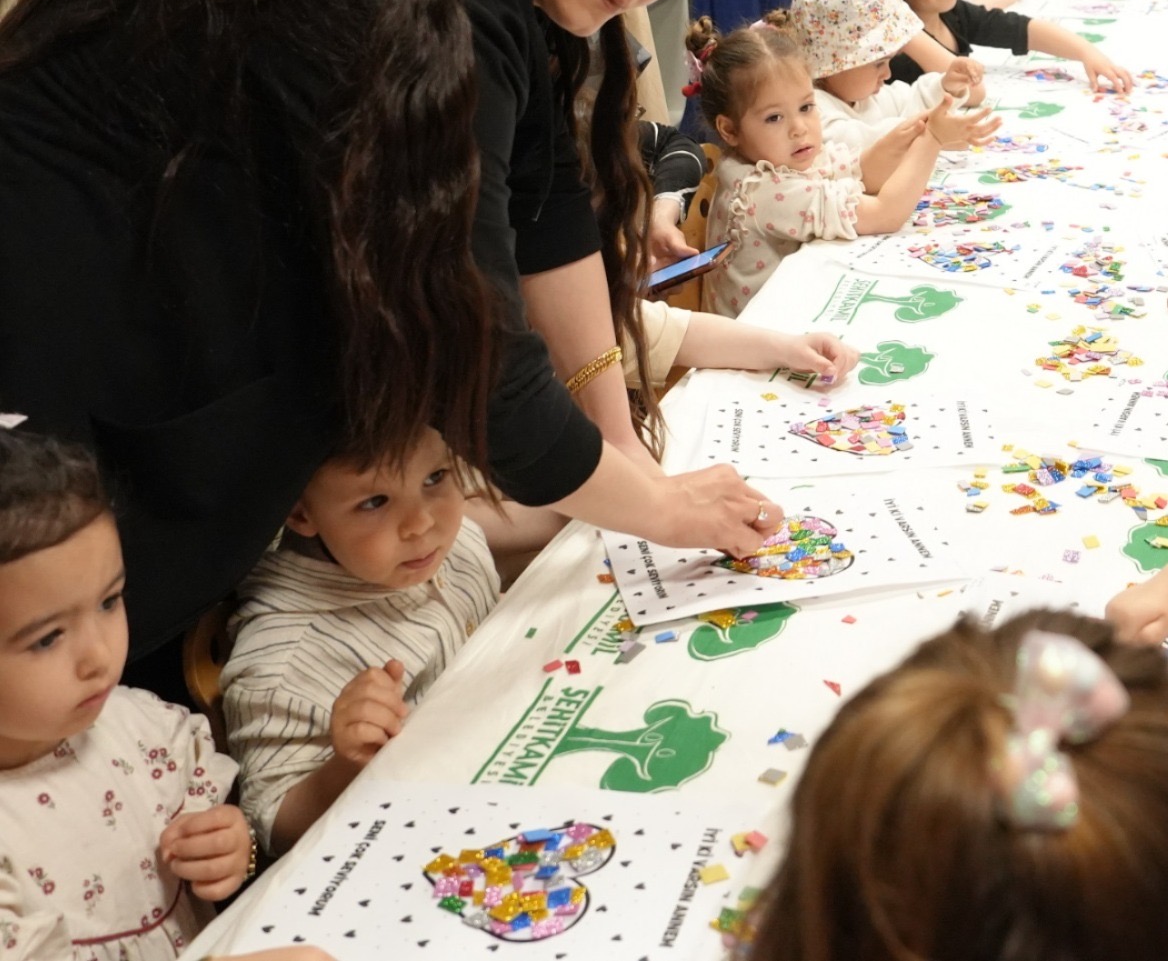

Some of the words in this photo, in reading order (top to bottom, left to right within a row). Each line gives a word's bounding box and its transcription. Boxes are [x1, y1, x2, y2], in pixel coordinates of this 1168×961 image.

[497, 686, 590, 787] ŞEHİTKAMİ
[349, 841, 371, 860] ÇOK
[363, 819, 387, 841] SENİ
[307, 861, 357, 916] SEVİYORUM
[658, 904, 690, 948] ANNEM
